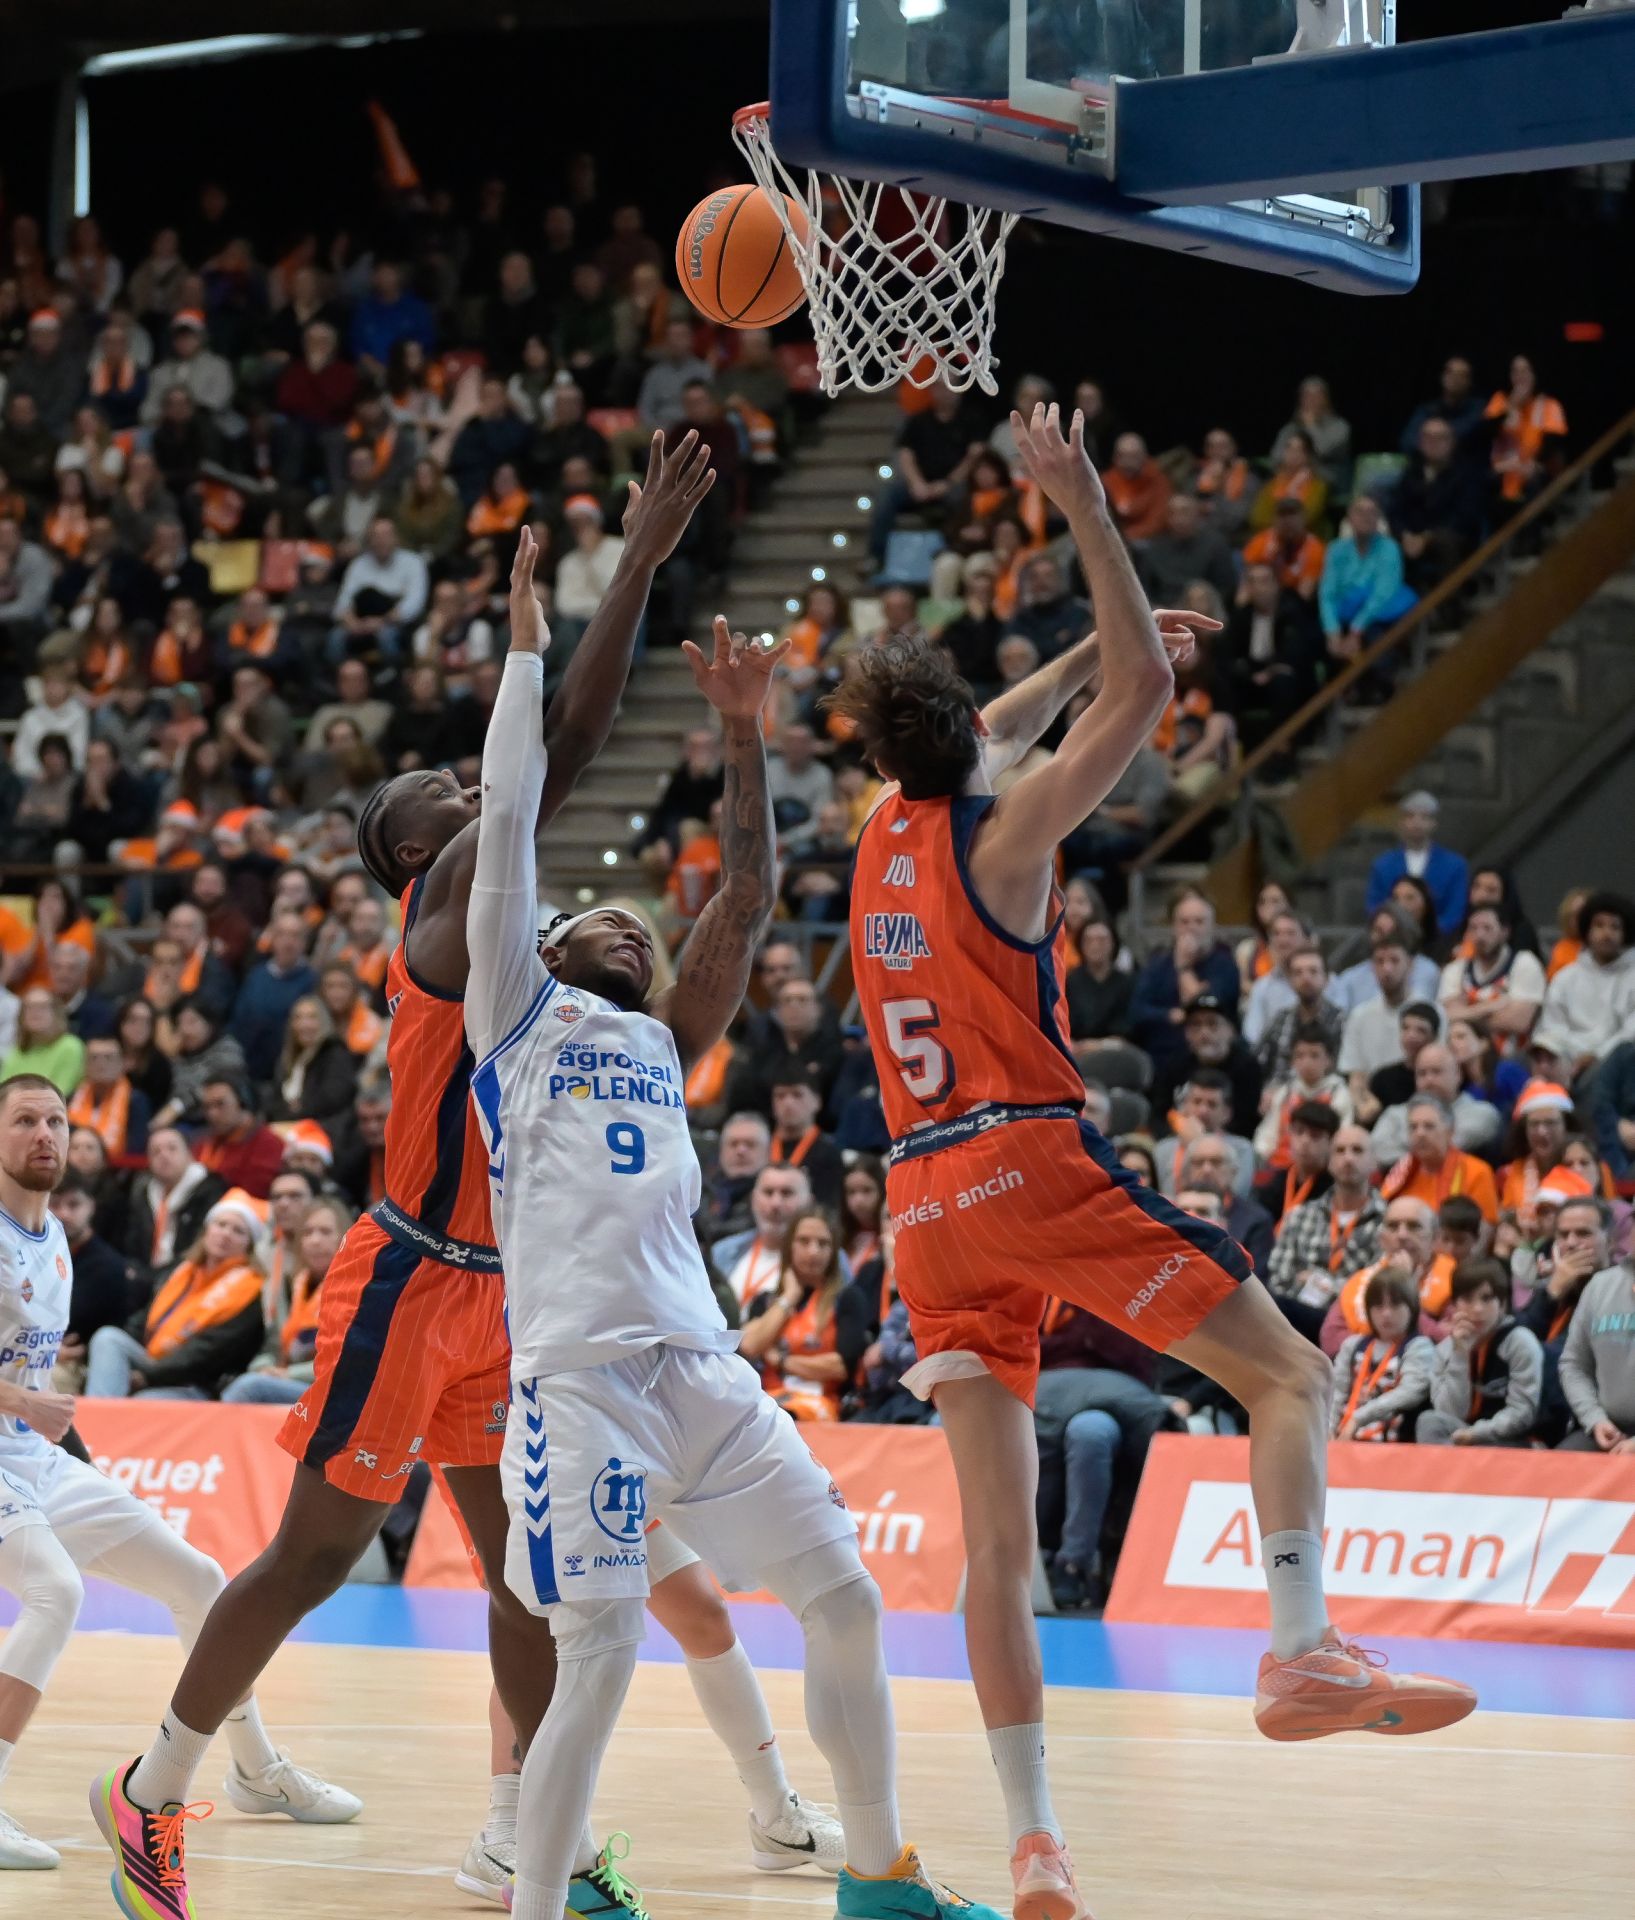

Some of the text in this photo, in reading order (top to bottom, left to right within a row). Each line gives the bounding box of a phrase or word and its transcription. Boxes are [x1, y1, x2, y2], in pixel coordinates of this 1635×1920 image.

[690, 192, 736, 280] Wilson
[882, 854, 916, 888] JOU
[865, 913, 932, 957] LEYMA
[557, 1050, 673, 1084] agropal
[881, 998, 955, 1105] 5
[605, 1121, 645, 1175] 9
[892, 1166, 1024, 1235] ordés ancín
[88, 1444, 224, 1494] squet
[593, 1552, 648, 1569] INMAP
[1202, 1508, 1506, 1580] Aman
